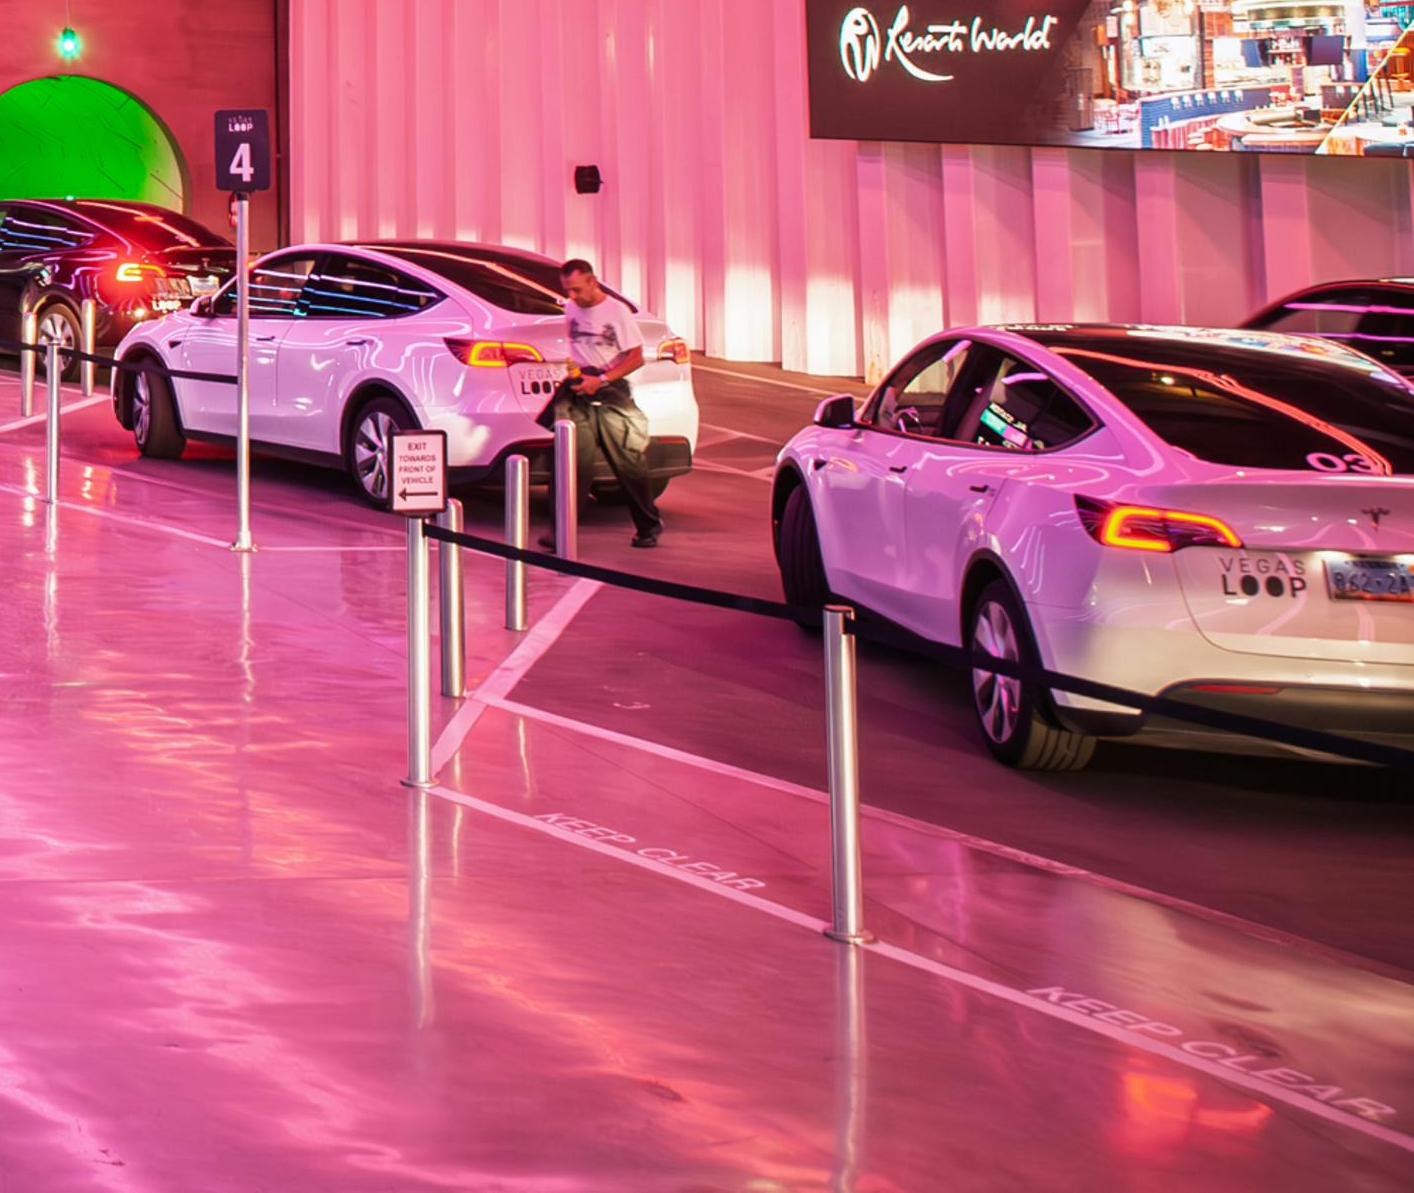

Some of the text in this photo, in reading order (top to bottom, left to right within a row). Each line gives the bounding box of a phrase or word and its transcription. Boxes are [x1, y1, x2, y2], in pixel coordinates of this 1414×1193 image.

[229, 123, 253, 132] LOOP
[229, 143, 254, 182] 4
[1220, 557, 1305, 576] VEGAS
[1221, 574, 1307, 598] LOOP
[535, 812, 766, 890] KEEP CLEAR
[1026, 986, 1397, 1117] KEEP CLEAR
